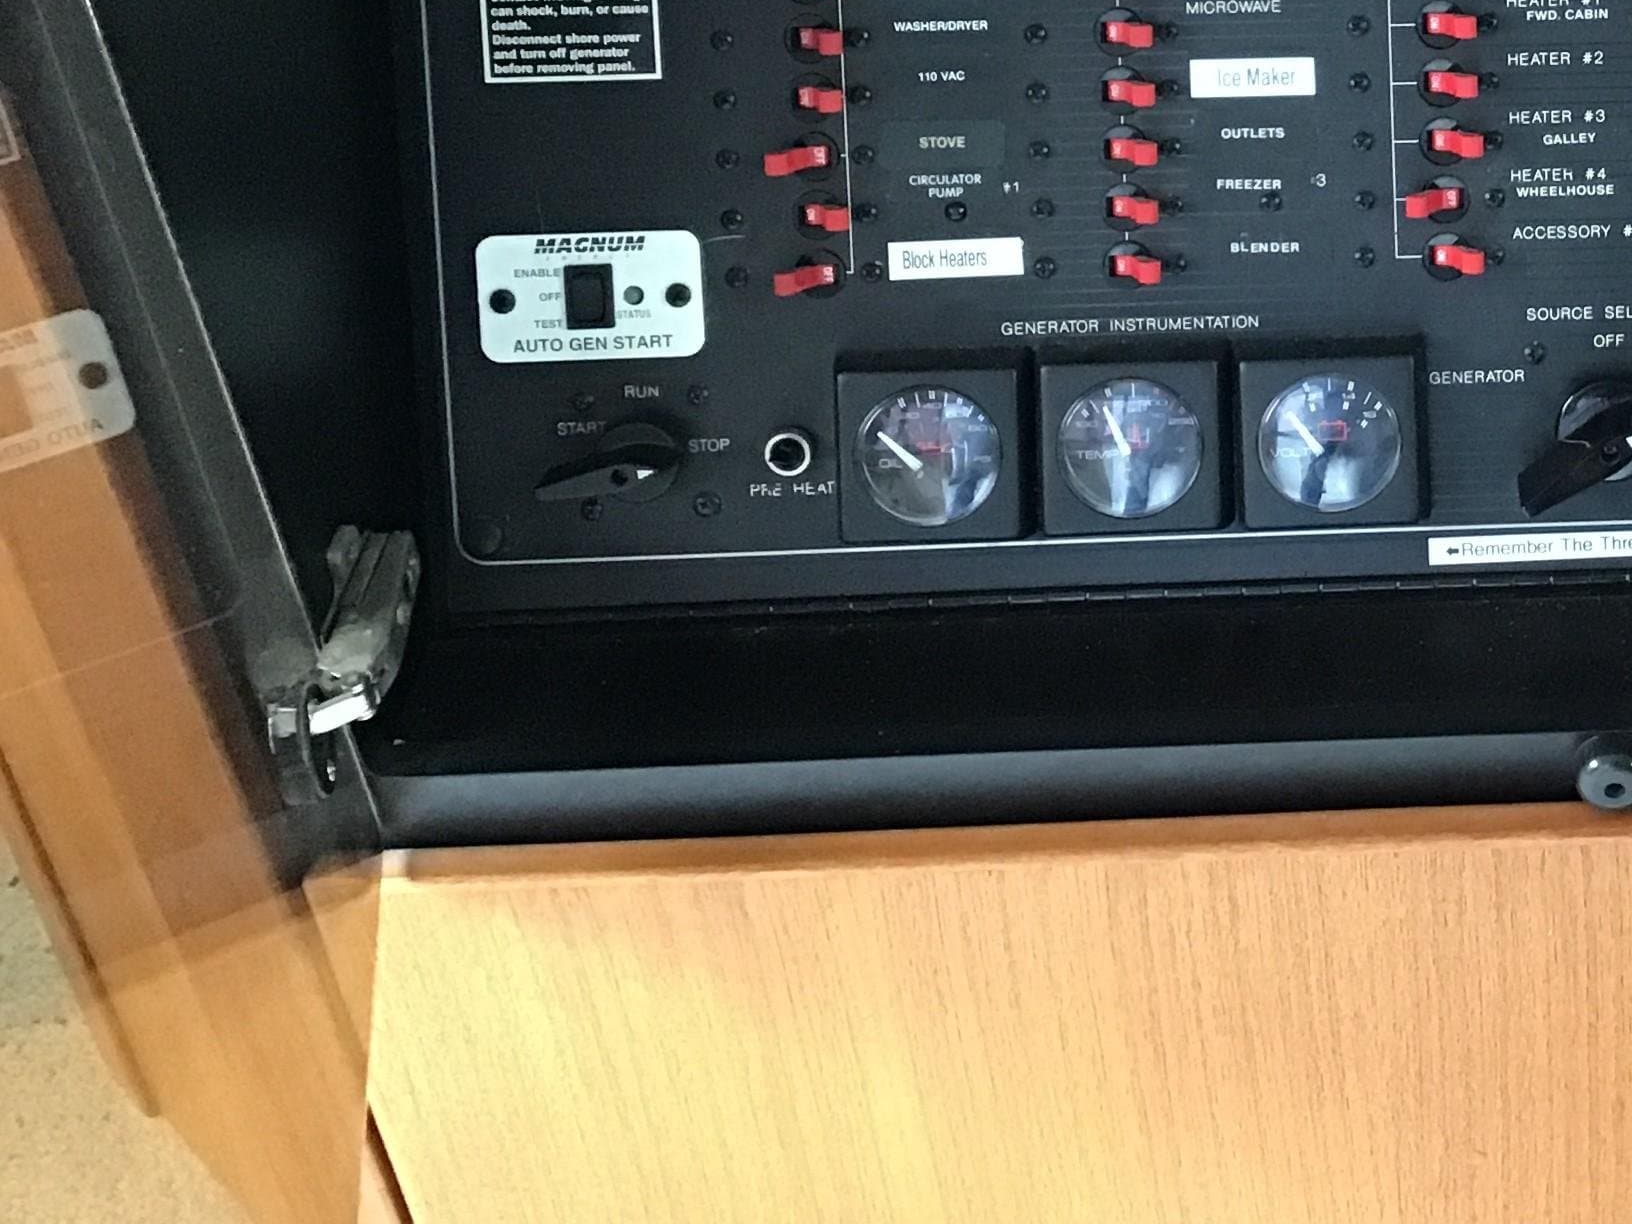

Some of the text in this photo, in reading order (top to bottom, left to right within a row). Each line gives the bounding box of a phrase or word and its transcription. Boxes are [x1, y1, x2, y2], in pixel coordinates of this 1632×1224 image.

[1186, 0, 1281, 14] MICROWAVE
[1565, 9, 1608, 20] CABIN
[894, 20, 988, 31] WASHER/DRYER
[919, 71, 965, 81] 110 VAC
[1217, 179, 1281, 189] FREEZER
[1517, 185, 1613, 197] WHEELHOUSE
[1513, 225, 1610, 239] ACCESSORY
[535, 236, 645, 254] MAGNUM
[1231, 242, 1299, 253] BLENDER
[903, 249, 987, 269] Block Heaters
[1527, 306, 1593, 321] SOURCE
[1001, 315, 1258, 335] GENERATOR INSTRUMENTATION
[514, 335, 672, 352] AUTO GEN START
[1594, 334, 1624, 347] OFF
[1430, 369, 1524, 384] GENERATOR
[625, 385, 659, 398] RUN
[557, 421, 606, 435] START
[690, 438, 730, 452] STOP
[1462, 541, 1552, 556] Remember
[1563, 538, 1592, 551] The
